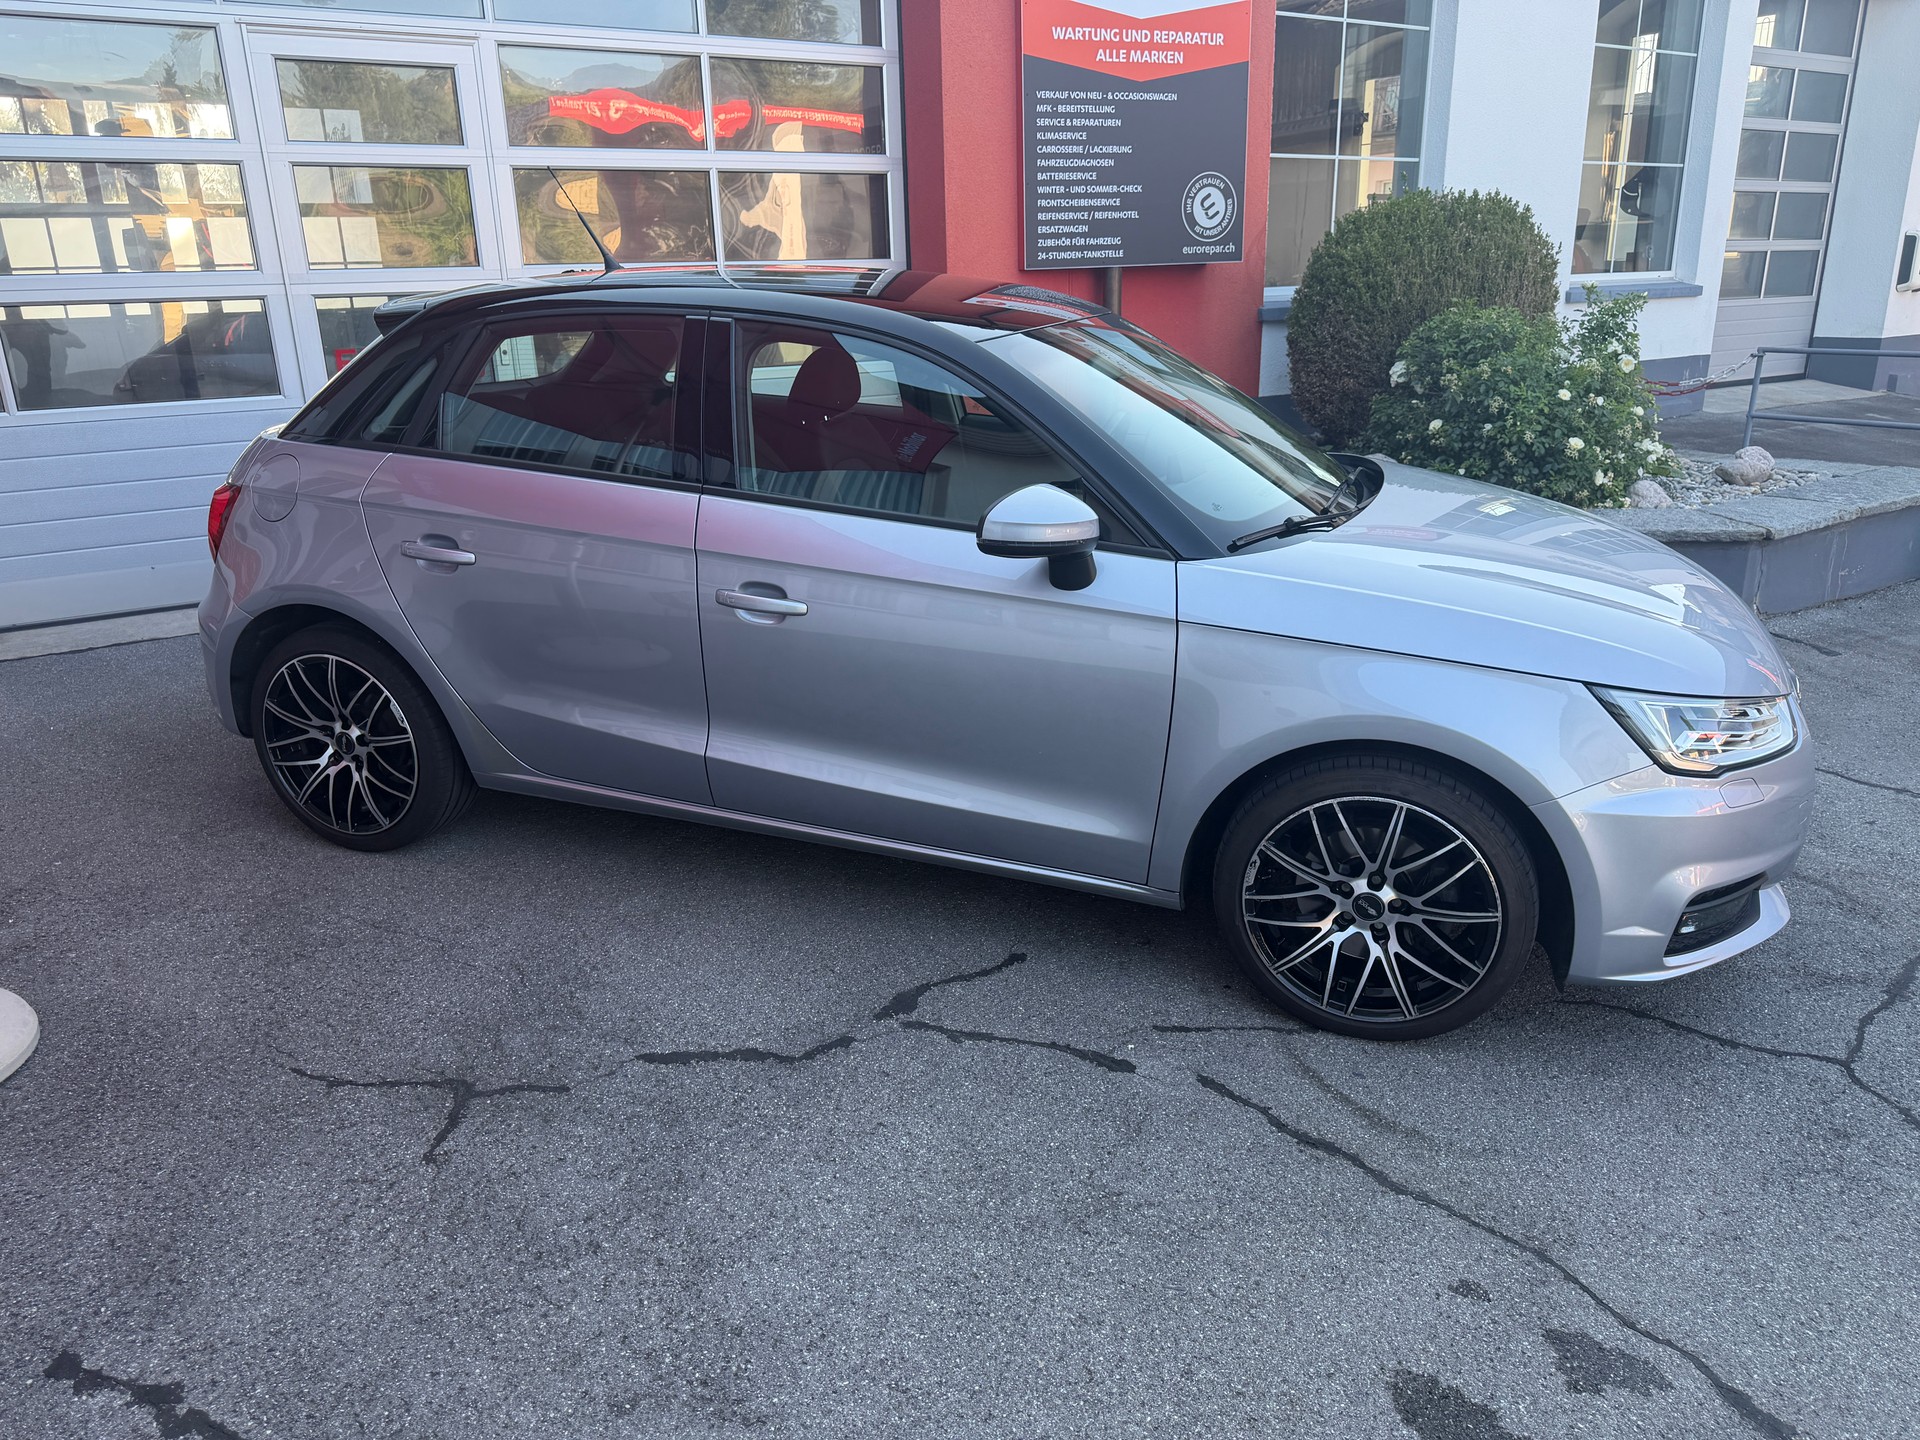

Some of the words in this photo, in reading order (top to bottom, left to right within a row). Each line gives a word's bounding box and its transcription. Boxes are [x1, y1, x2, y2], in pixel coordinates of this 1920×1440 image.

[1052, 26, 1120, 42] WARTUNG
[1122, 29, 1151, 43] UND
[1153, 30, 1224, 46] REPARATUR
[1095, 49, 1127, 63] ALLE
[1129, 50, 1184, 64] MARKEN
[1036, 91, 1069, 99] VERKAUF
[1070, 91, 1086, 99] VON
[1114, 92, 1178, 101] OCCASIONSWAGEN
[1058, 105, 1116, 113] BEREITSTELLUNG
[1036, 118, 1065, 126] SERVICE
[1072, 119, 1122, 127] REPARATUREN
[1036, 146, 1084, 154] CARROSSERIE
[1090, 146, 1132, 154] LACKIERUNG
[1037, 172, 1097, 180] BATTERIESERVICE
[1086, 185, 1142, 193] SOMMER-CHECK
[1189, 178, 1226, 197] VERTRAUEN
[1038, 198, 1120, 207] FRONTSCHEIBENSERVICE
[1038, 212, 1088, 220] REIFENSERVICE
[1094, 211, 1139, 220] REIFENHOTEL
[1038, 225, 1088, 234] ERSATZWAGEN
[1038, 238, 1071, 246] ZUBEHÖR
[1072, 236, 1086, 246] FÜR
[1086, 237, 1122, 246] FAHRZEUG
[1182, 242, 1236, 256] eurorepar.ch
[1038, 250, 1124, 260] 24-STUNDEN-TANKSTELLE
